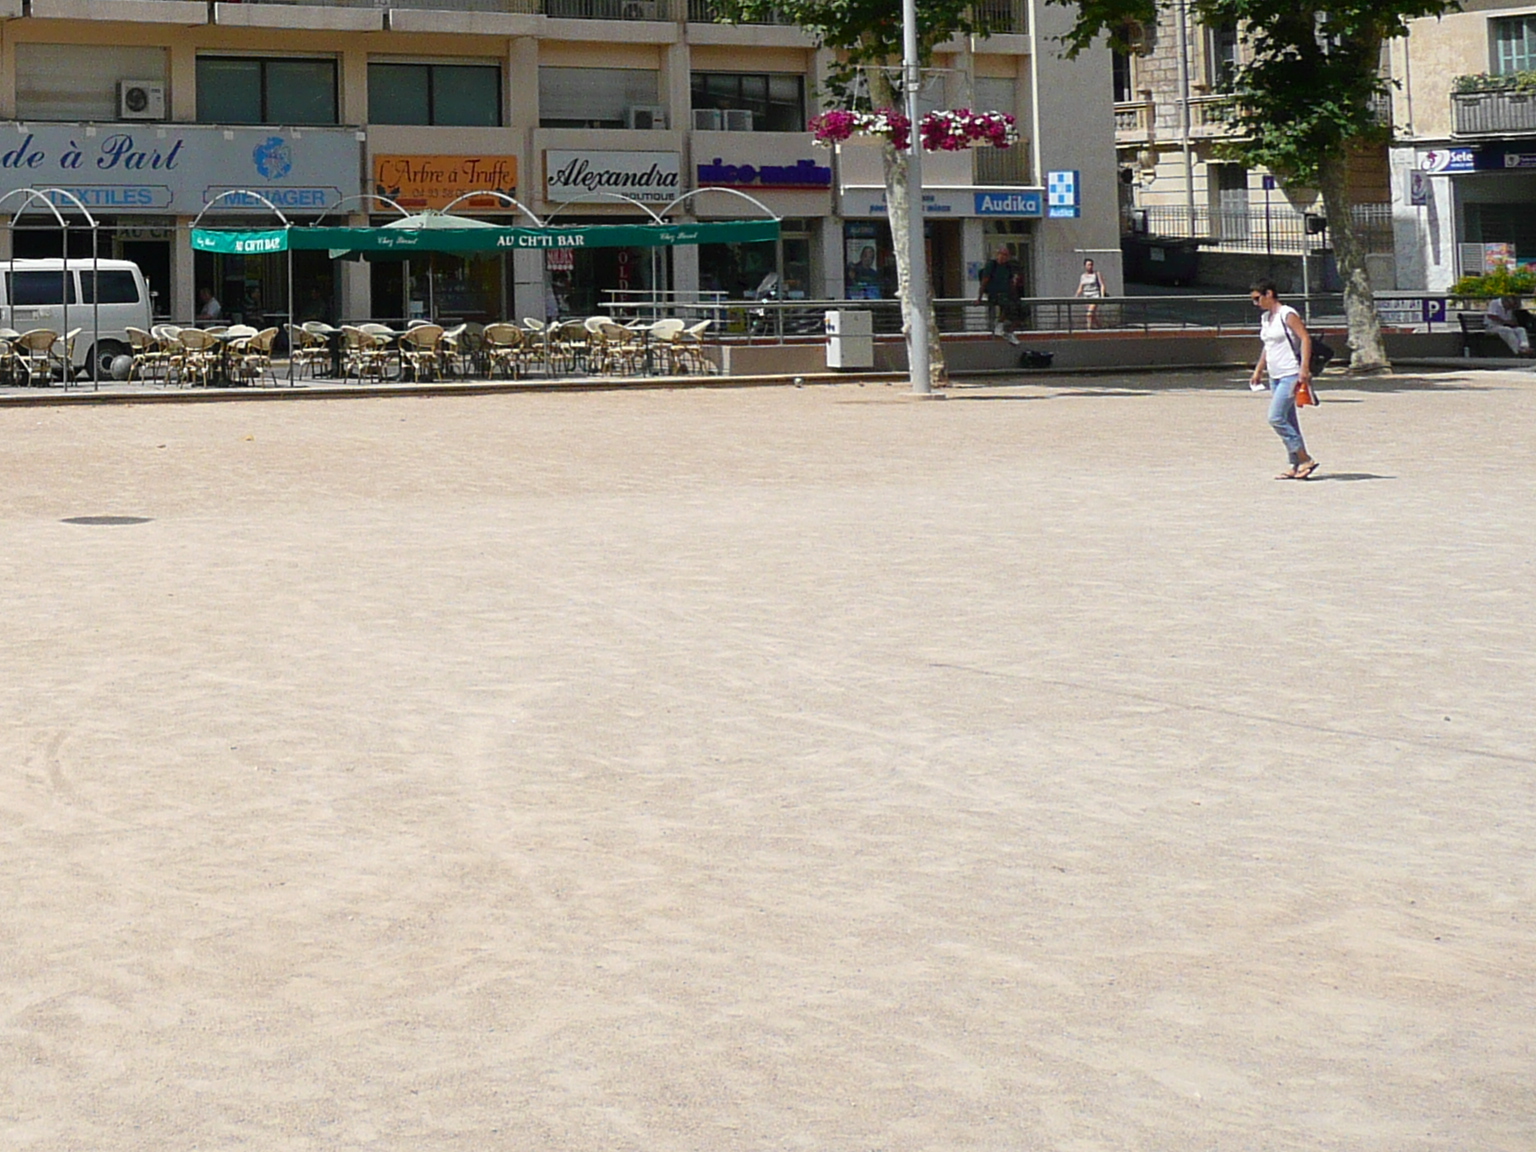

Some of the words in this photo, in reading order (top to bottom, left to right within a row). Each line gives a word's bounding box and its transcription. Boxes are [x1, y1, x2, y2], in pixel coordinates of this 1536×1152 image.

[60, 139, 84, 169] à
[96, 133, 186, 171] Part
[548, 157, 679, 192] Alexandra
[50, 188, 153, 206] TEXTILES
[223, 189, 326, 206] MENAGER
[981, 195, 1037, 212] Audika
[496, 234, 515, 247] AU
[519, 234, 553, 247] CH'TI
[557, 234, 585, 247] BAR
[1428, 300, 1441, 319] P
